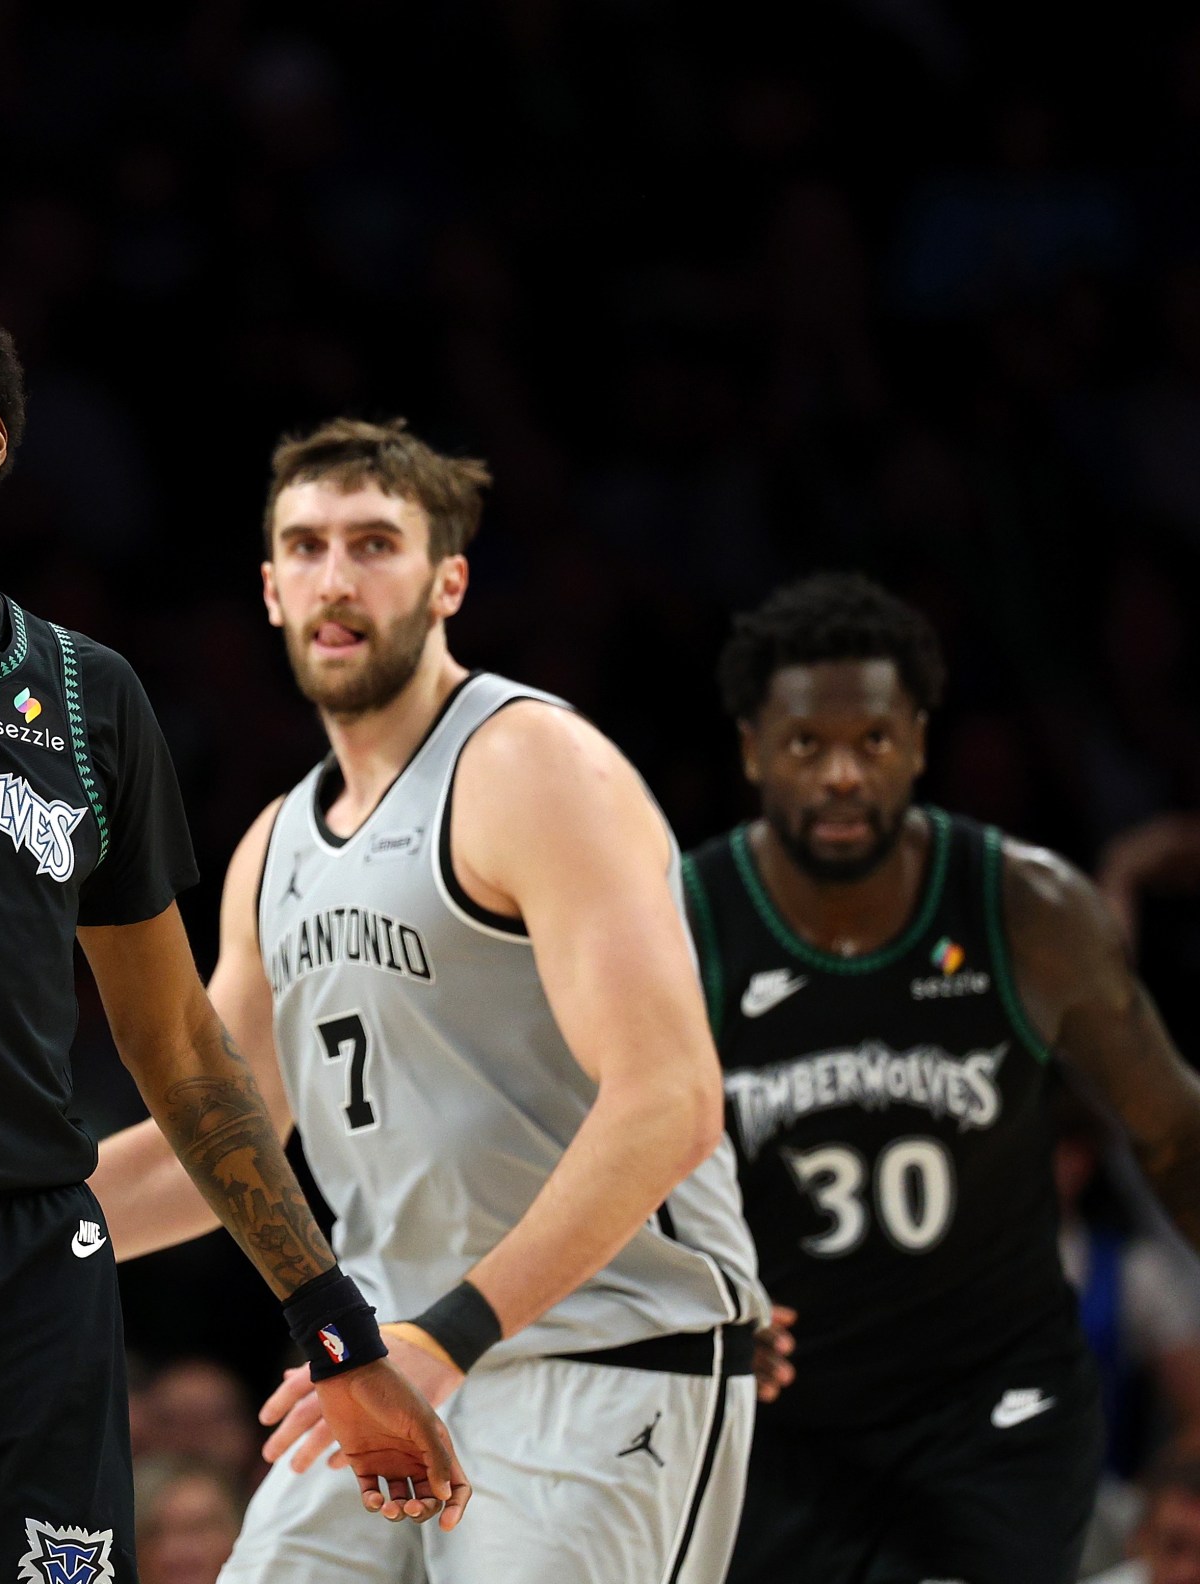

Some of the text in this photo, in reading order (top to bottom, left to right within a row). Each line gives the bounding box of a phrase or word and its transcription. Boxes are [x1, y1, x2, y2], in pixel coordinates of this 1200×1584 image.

[296, 906, 434, 982] ANTONIO
[315, 1010, 378, 1133] 7
[79, 1219, 101, 1244] NIKE
[778, 1134, 957, 1260] 30
